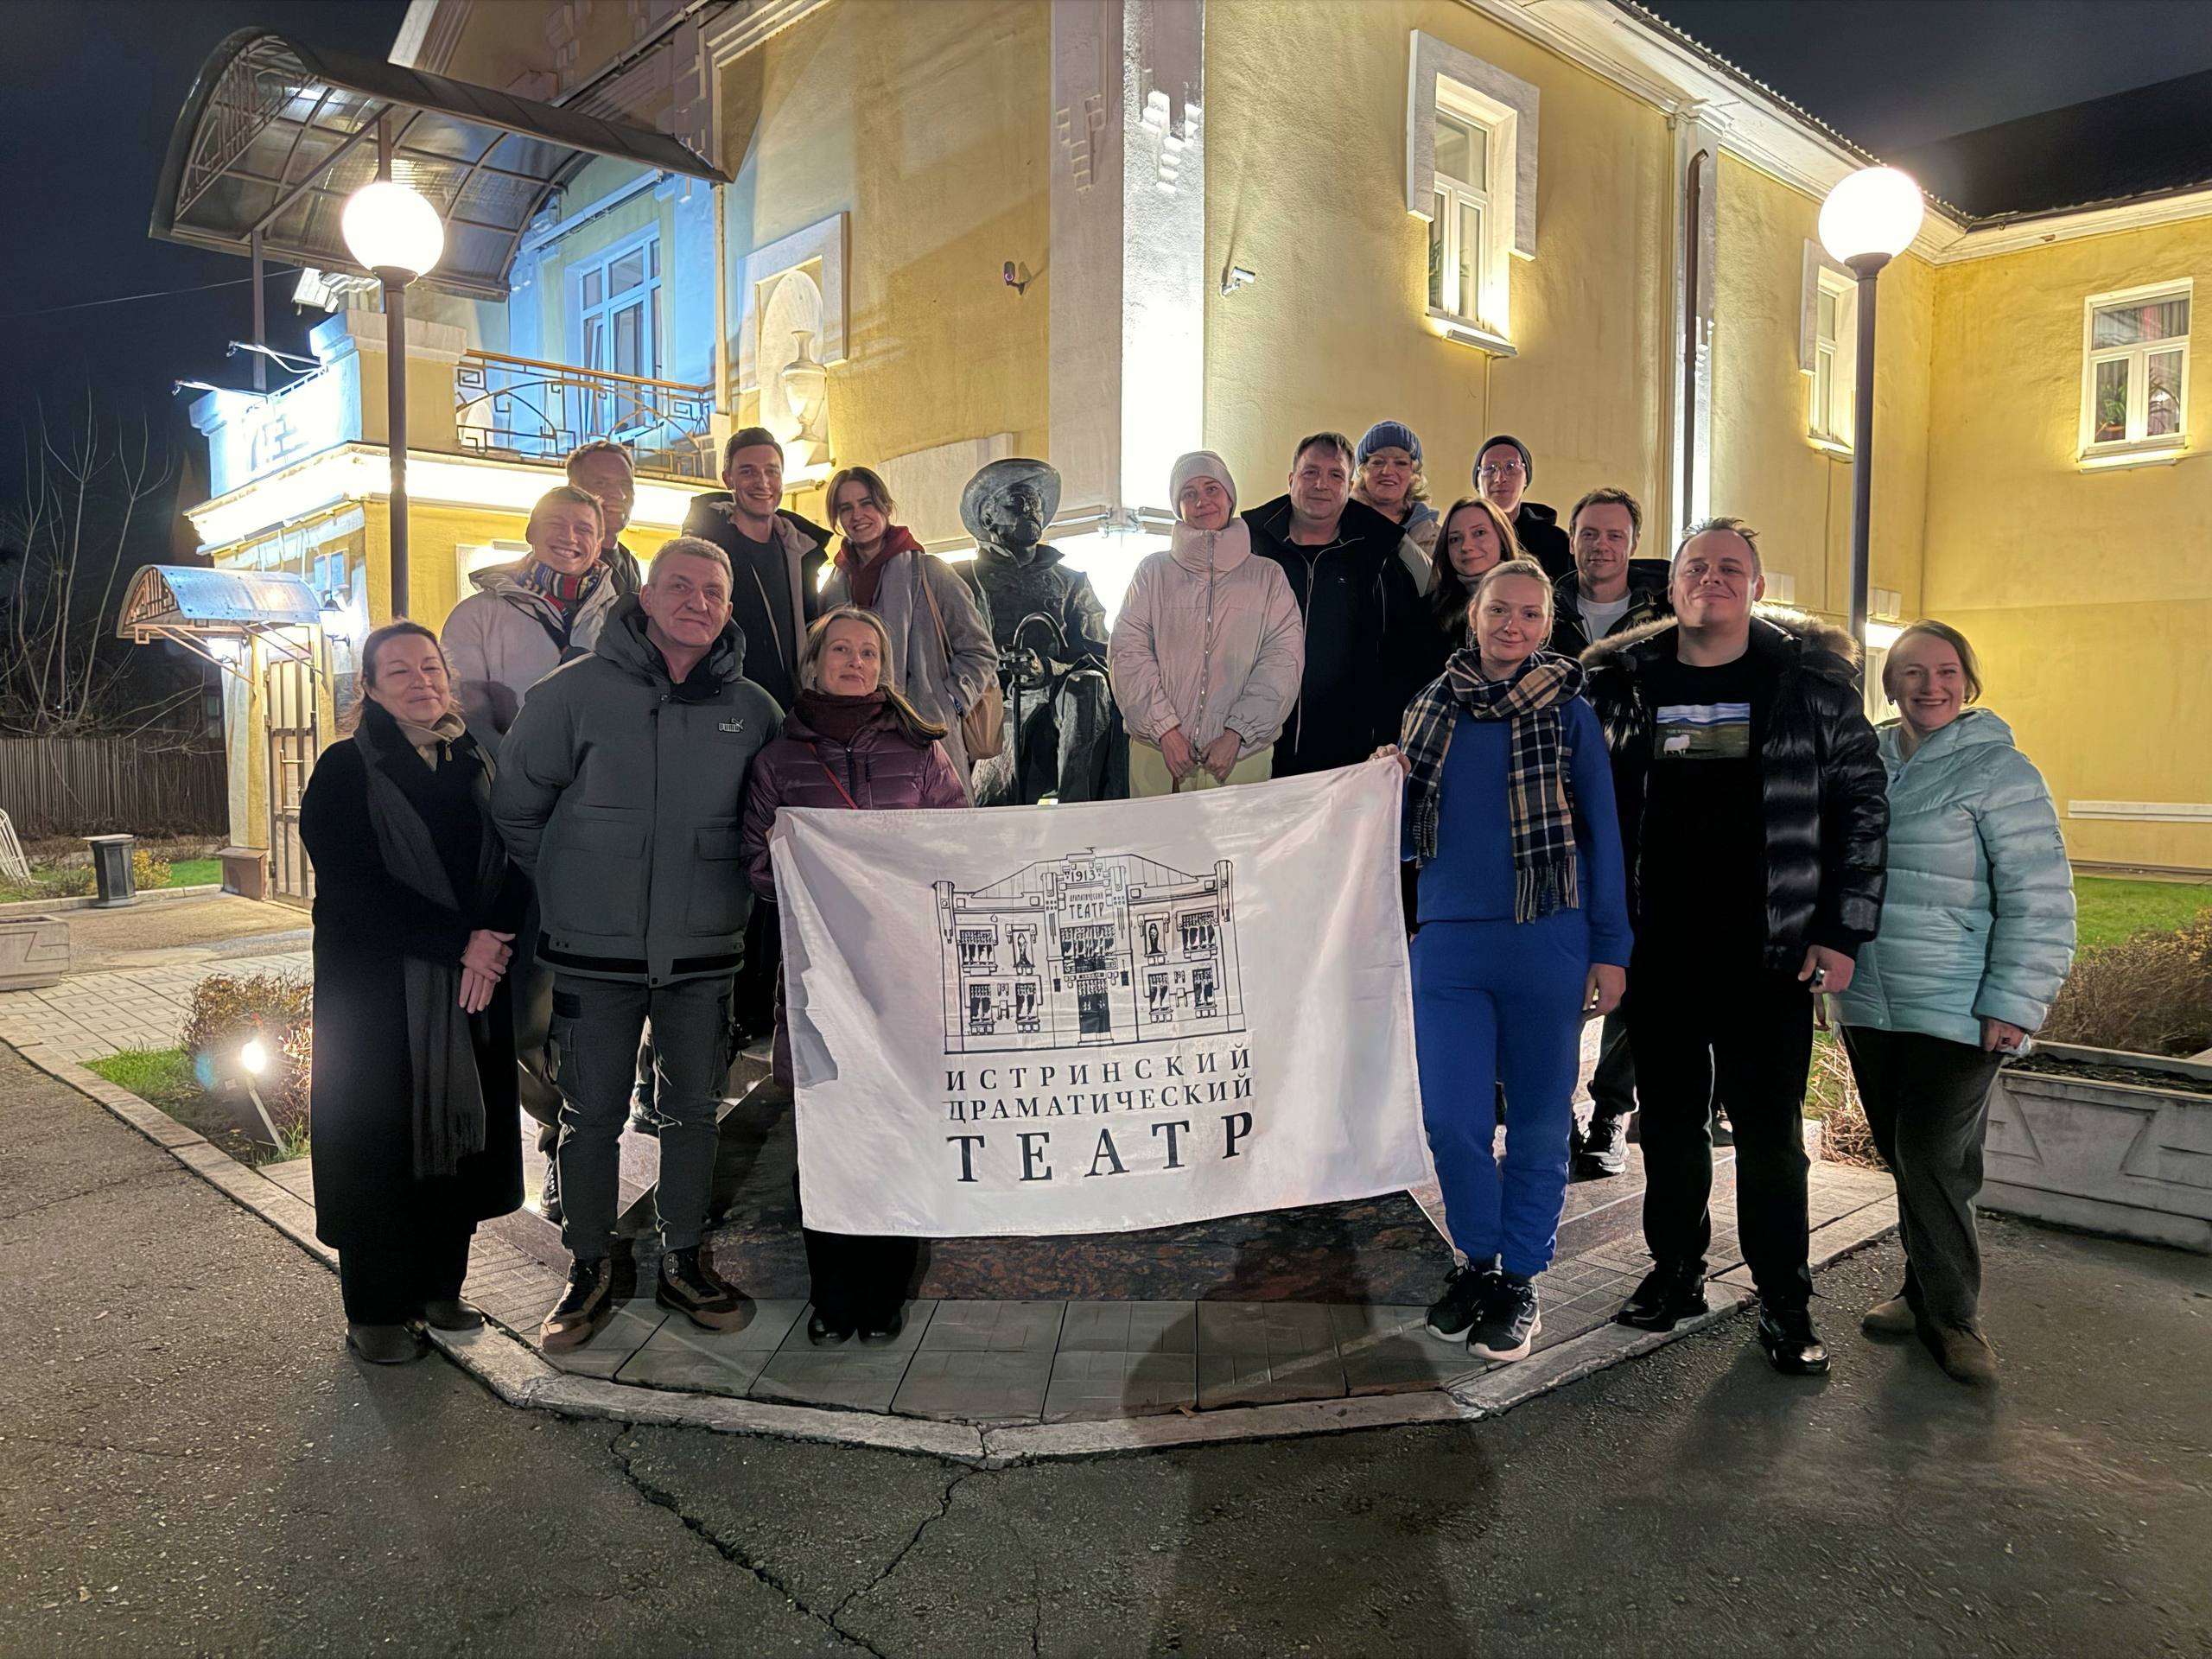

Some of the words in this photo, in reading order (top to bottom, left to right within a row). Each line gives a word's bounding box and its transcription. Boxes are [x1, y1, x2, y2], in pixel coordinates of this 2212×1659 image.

[1071, 870, 1096, 881] 1913
[1069, 902, 1104, 919] ТЕАТР
[945, 1042, 1251, 1091] ИСТРИНСКИЙ
[942, 1073, 1252, 1123] ДРАМАТИЧЕСКИЙ
[946, 1111, 1253, 1183] ТЕАТР
